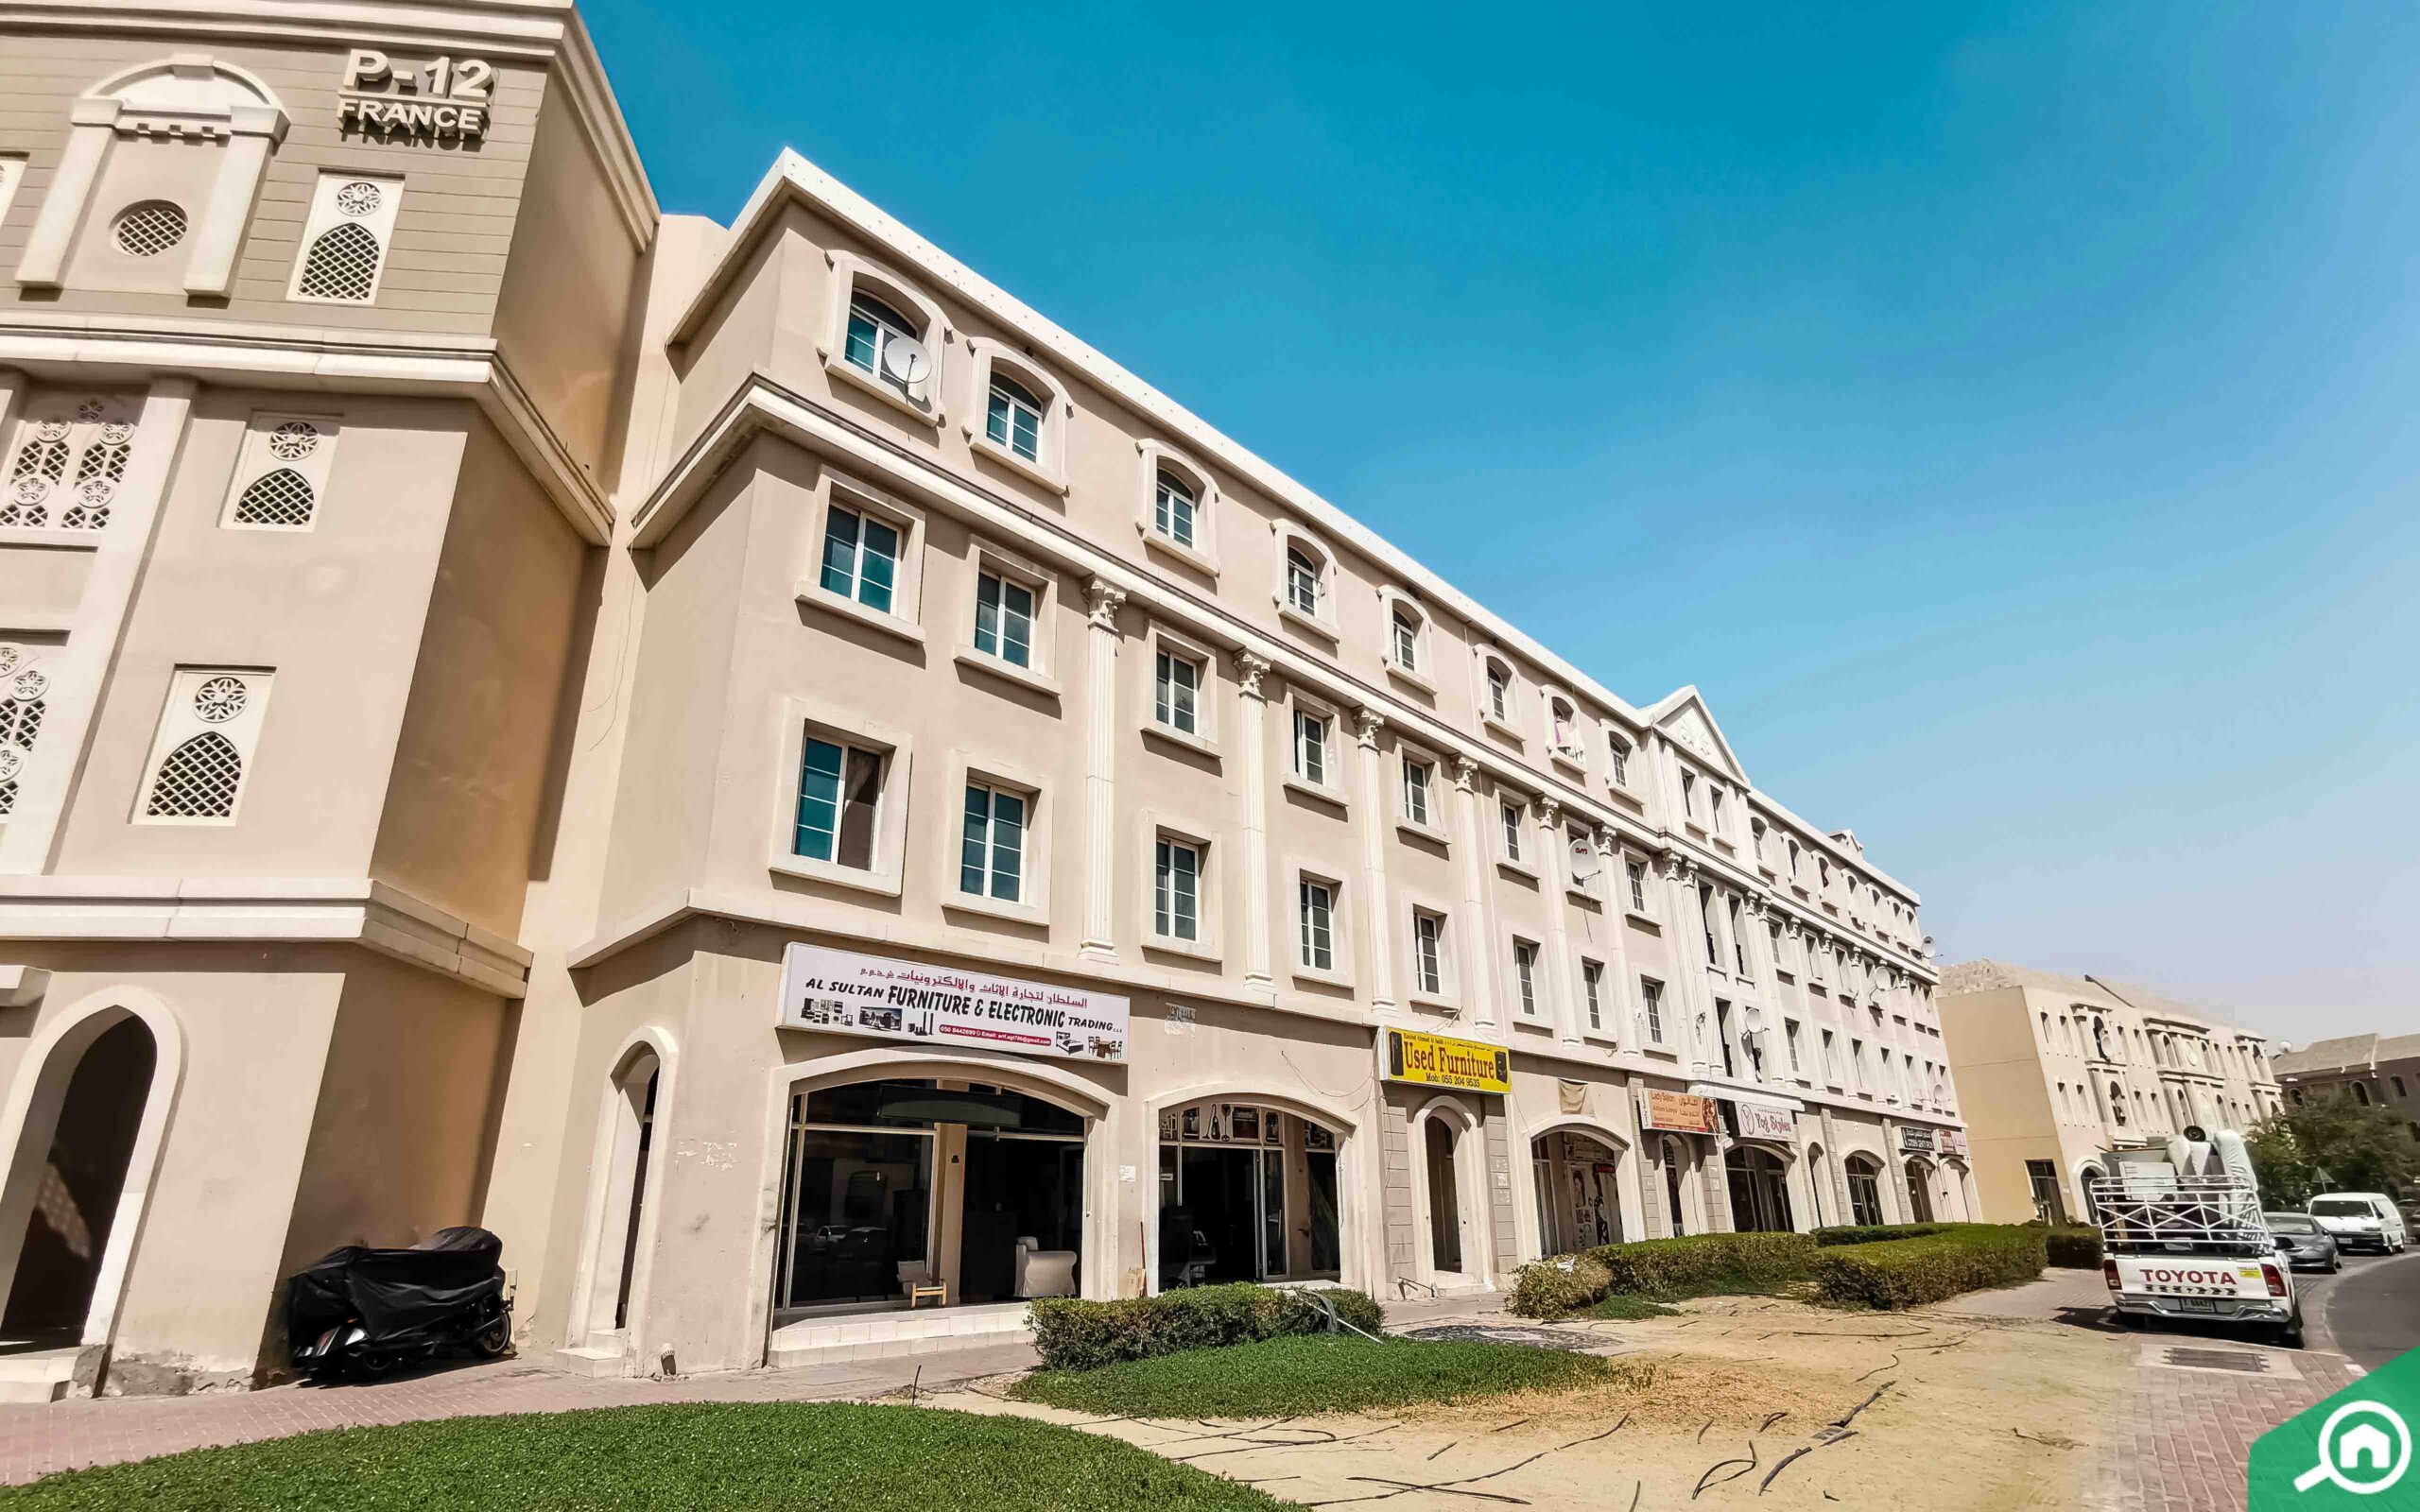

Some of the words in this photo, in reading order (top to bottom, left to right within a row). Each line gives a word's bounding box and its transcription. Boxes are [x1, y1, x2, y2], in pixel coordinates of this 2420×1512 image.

[343, 48, 493, 98] P-12
[337, 98, 483, 130] FRANCE
[805, 977, 823, 990] AL
[829, 981, 884, 998] SULTAN
[887, 985, 972, 1016] FURNITURE
[975, 998, 984, 1017] &
[989, 1000, 1065, 1029] ELECTRONIC
[1068, 1016, 1114, 1031] TRADING
[1403, 1040, 1436, 1072] Used
[1439, 1047, 1495, 1079] Furniture
[1426, 1073, 1441, 1083] Mob:
[1442, 1074, 1453, 1085] 055
[1454, 1075, 1465, 1086] 204
[2139, 1269, 2238, 1285] TOYOTA
